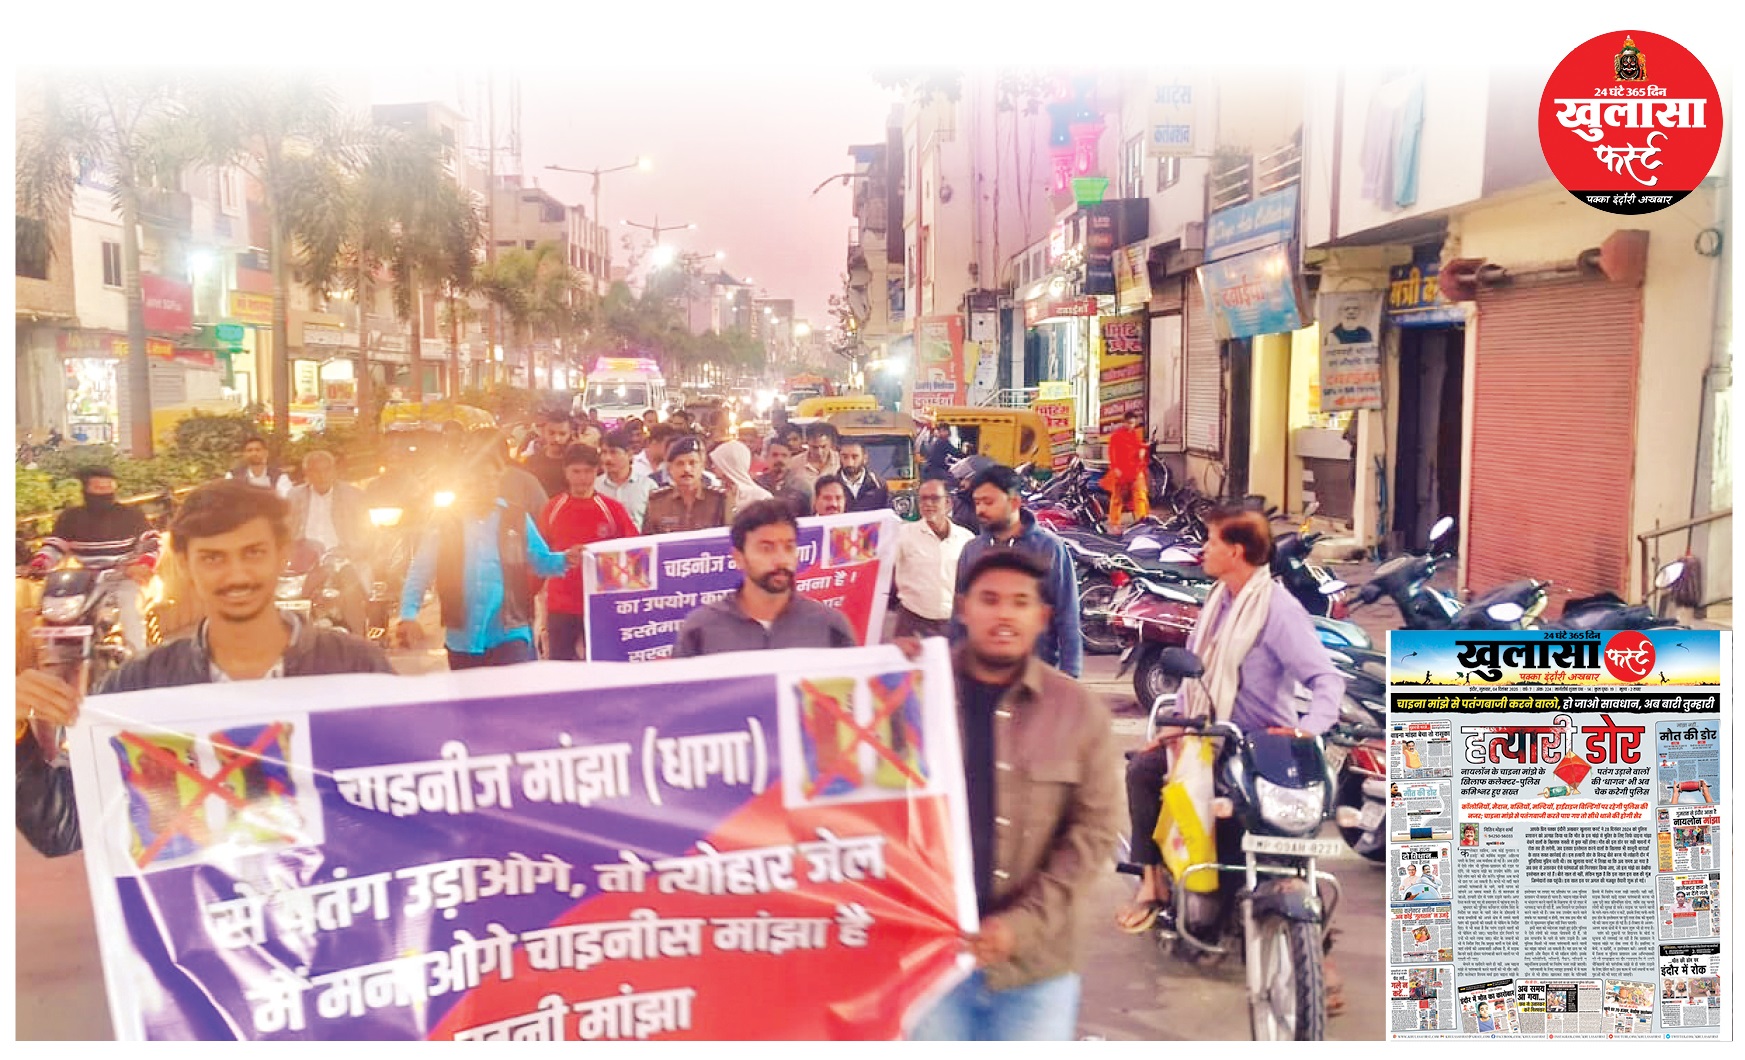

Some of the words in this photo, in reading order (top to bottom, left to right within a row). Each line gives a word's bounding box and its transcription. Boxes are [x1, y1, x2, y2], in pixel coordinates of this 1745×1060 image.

[615, 599, 639, 615] का
[643, 591, 697, 612] उपयोग
[797, 577, 831, 592] मना
[834, 570, 847, 588] है
[664, 551, 726, 578] चाइनीज
[620, 620, 684, 642] इस्तेमा
[332, 739, 514, 816] चाइनीज
[519, 732, 632, 808] मांझा
[641, 717, 768, 806] (धागा)
[206, 882, 267, 947] से
[396, 852, 586, 920] उड़ाओगे,
[594, 850, 651, 893] तो
[653, 841, 796, 896] त्योहार
[802, 826, 887, 882] जेल
[247, 965, 313, 1034] में
[307, 922, 518, 1020] मनाओगे
[524, 908, 707, 971] चाइनीस
[711, 910, 831, 953] मांझा
[834, 903, 875, 946] है
[573, 983, 696, 1041] मांझा
